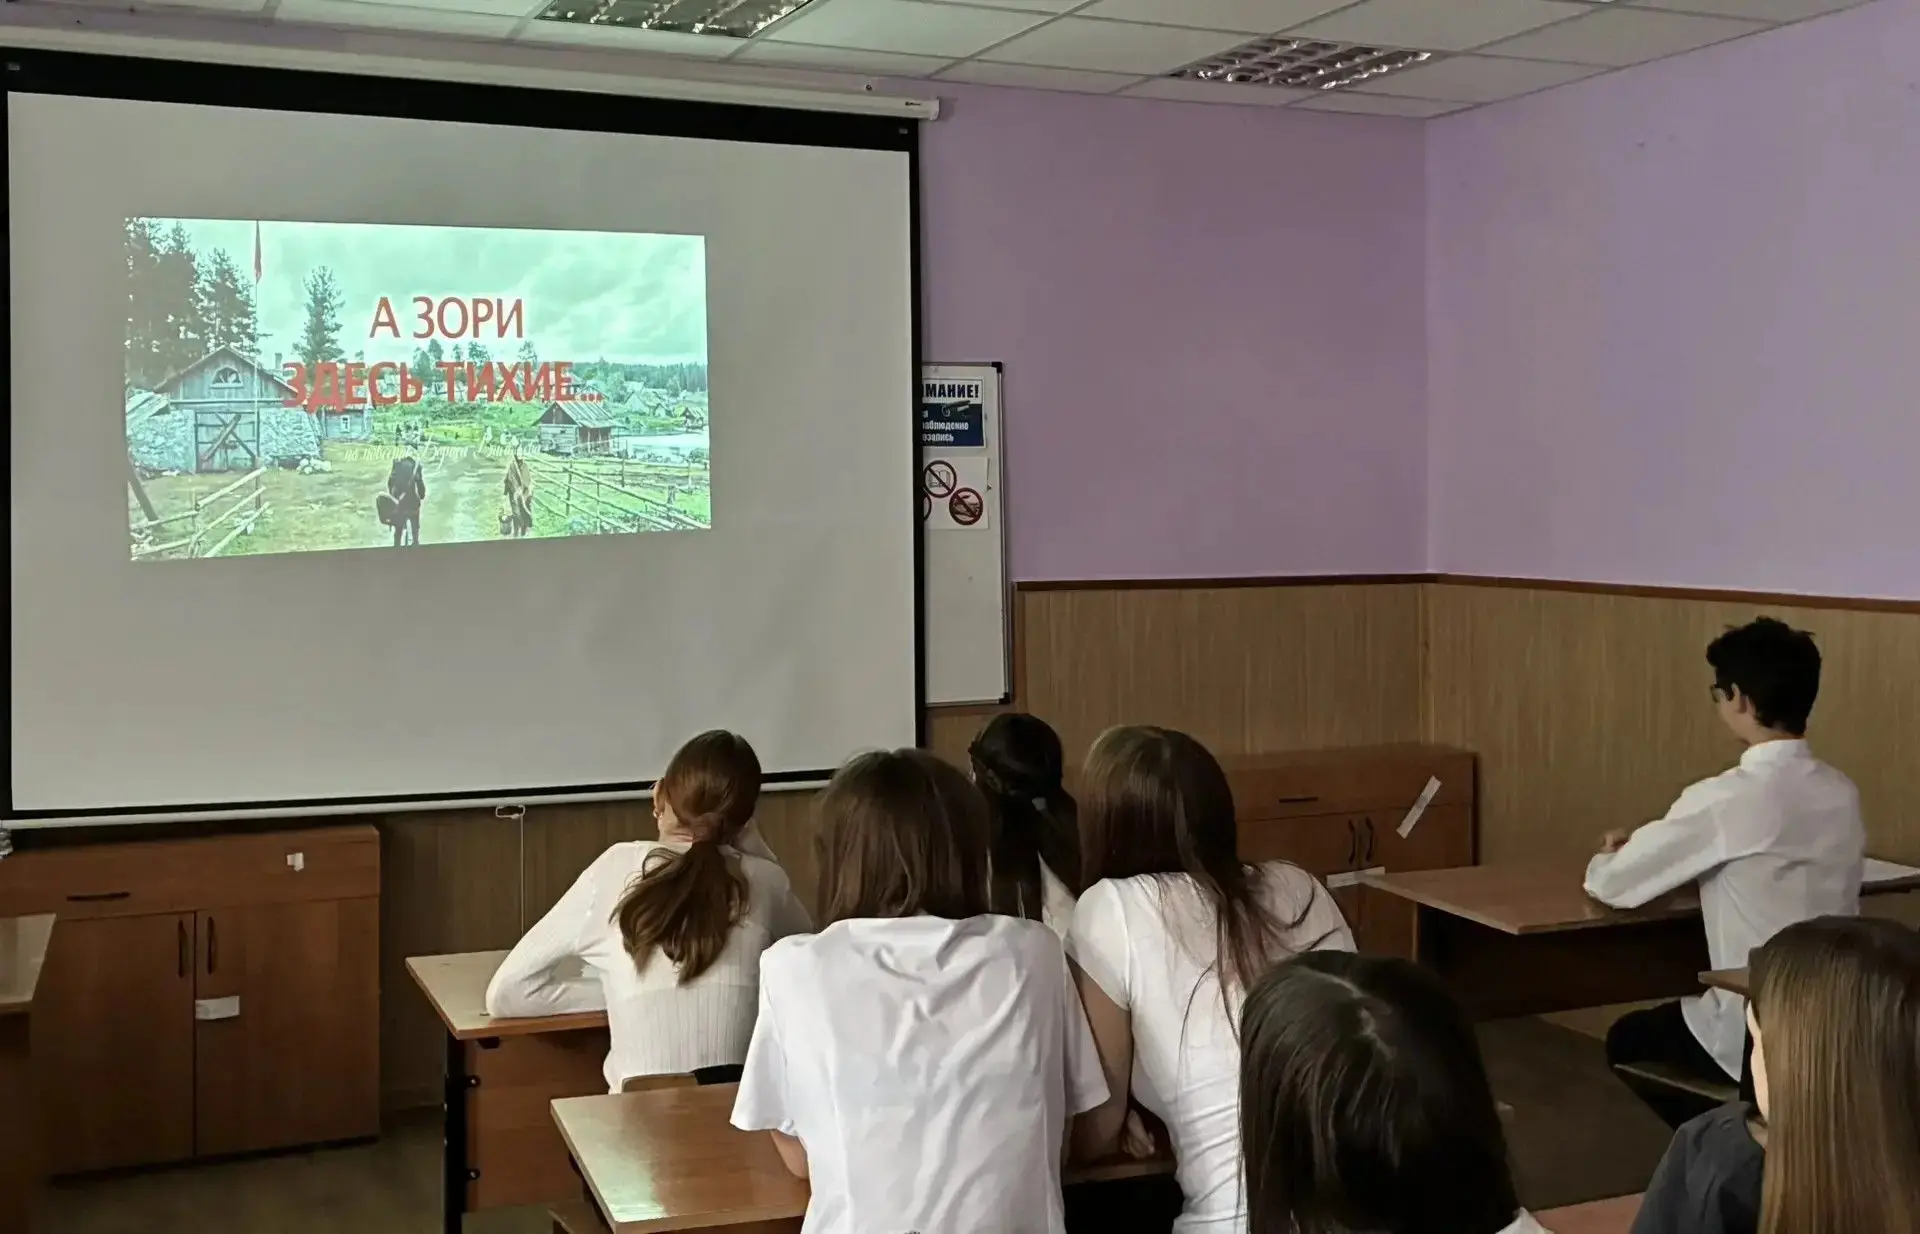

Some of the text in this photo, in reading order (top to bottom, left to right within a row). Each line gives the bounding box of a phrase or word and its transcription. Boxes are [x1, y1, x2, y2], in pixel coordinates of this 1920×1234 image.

[369, 296, 524, 339] А ЗОРИ
[282, 360, 603, 414] ЗДЕСЬ ТИХИЕ...
